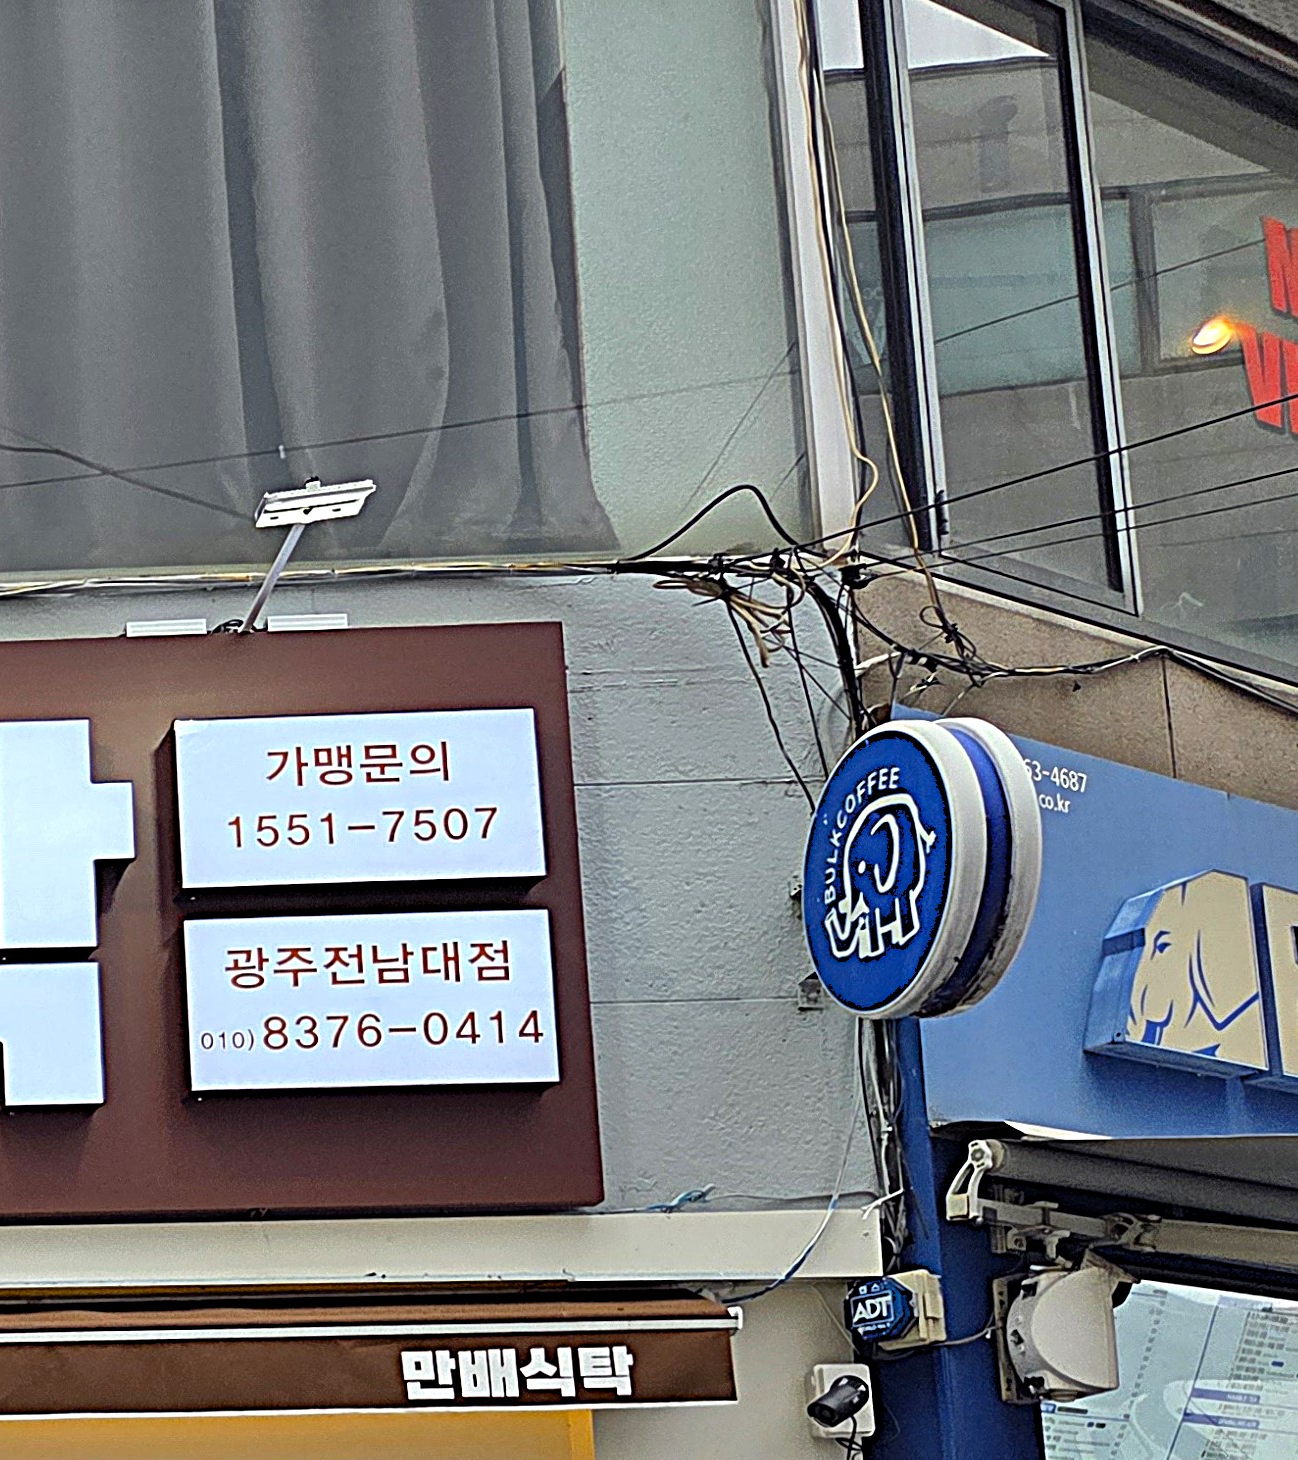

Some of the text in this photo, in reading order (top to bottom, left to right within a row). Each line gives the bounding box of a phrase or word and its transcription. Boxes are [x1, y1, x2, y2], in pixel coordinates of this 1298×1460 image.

[265, 741, 451, 787] 가맹문의
[227, 806, 499, 848] 1551-7507
[224, 939, 511, 988] 광주전남대점
[853, 1295, 892, 1323] ADT
[401, 1346, 633, 1399] 만배식탁
